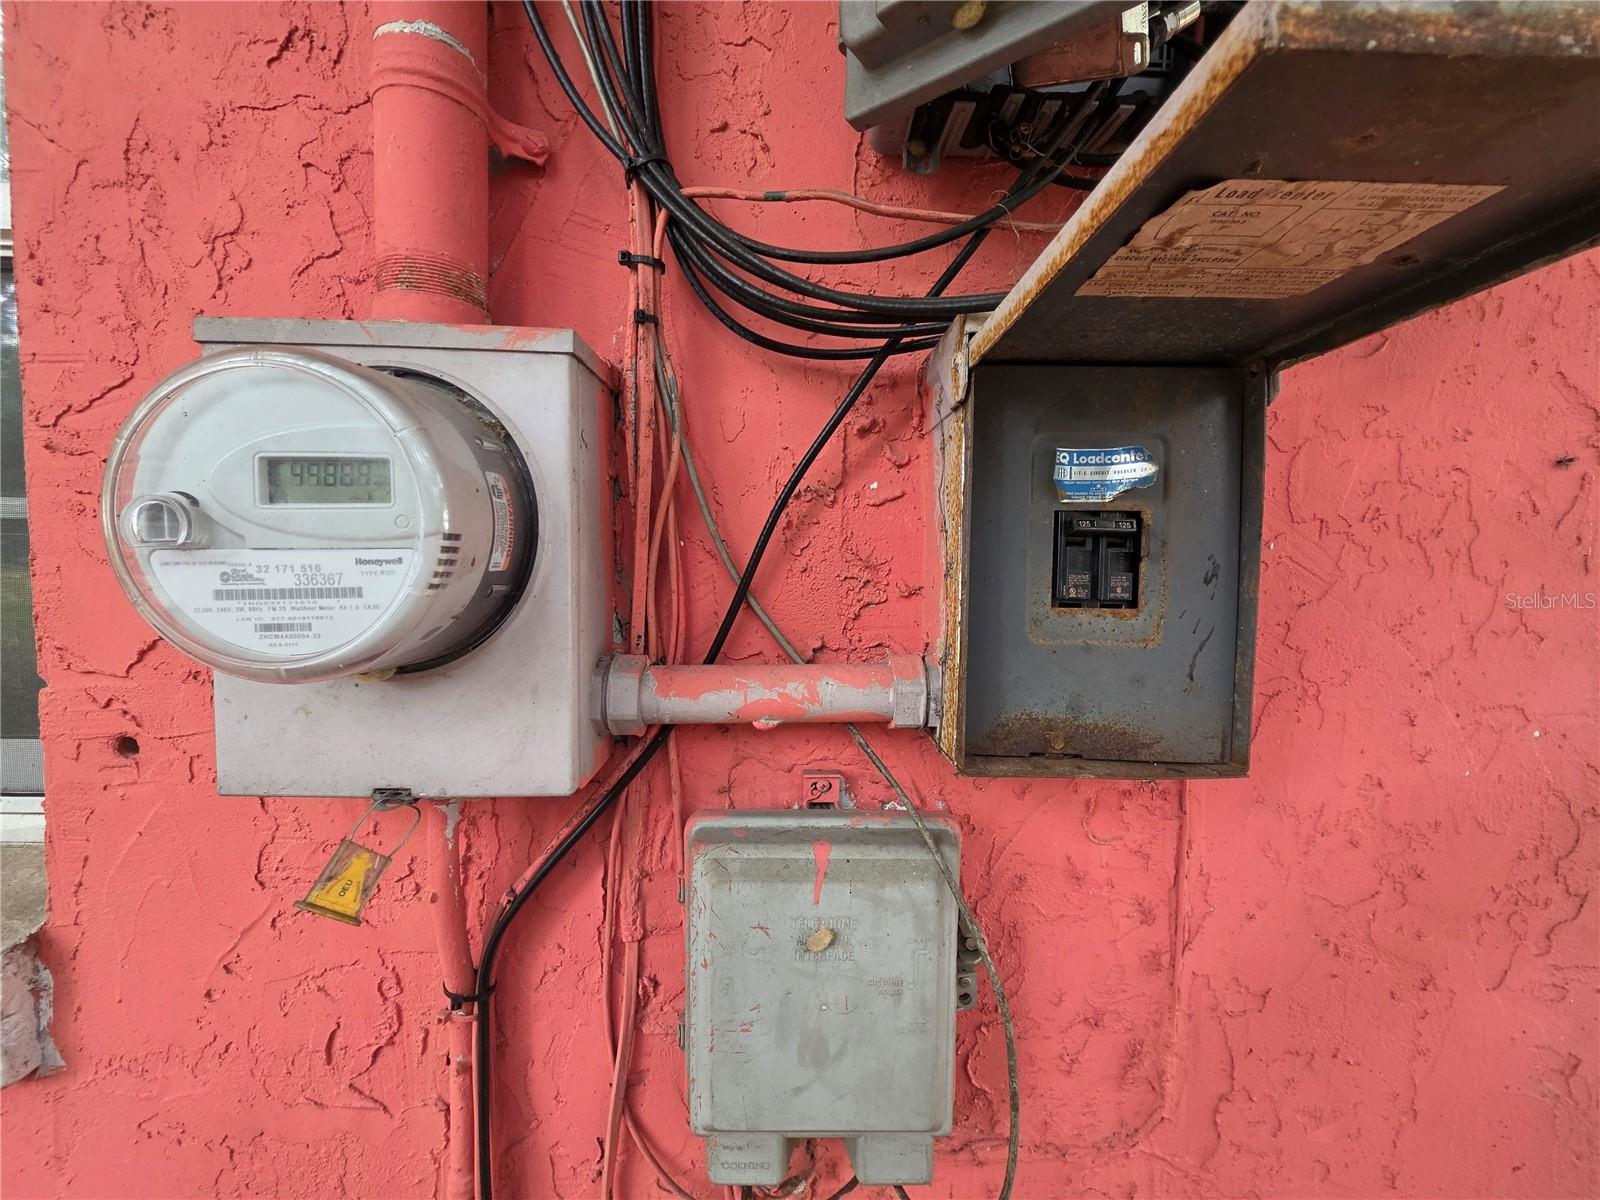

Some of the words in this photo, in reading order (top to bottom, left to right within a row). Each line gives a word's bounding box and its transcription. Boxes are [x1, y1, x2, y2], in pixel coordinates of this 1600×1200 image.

[1078, 520, 1091, 528] 125
[355, 557, 403, 567] Honeywell
[256, 564, 270, 574] 32
[275, 564, 294, 574] 171
[294, 572, 344, 587] 336367
